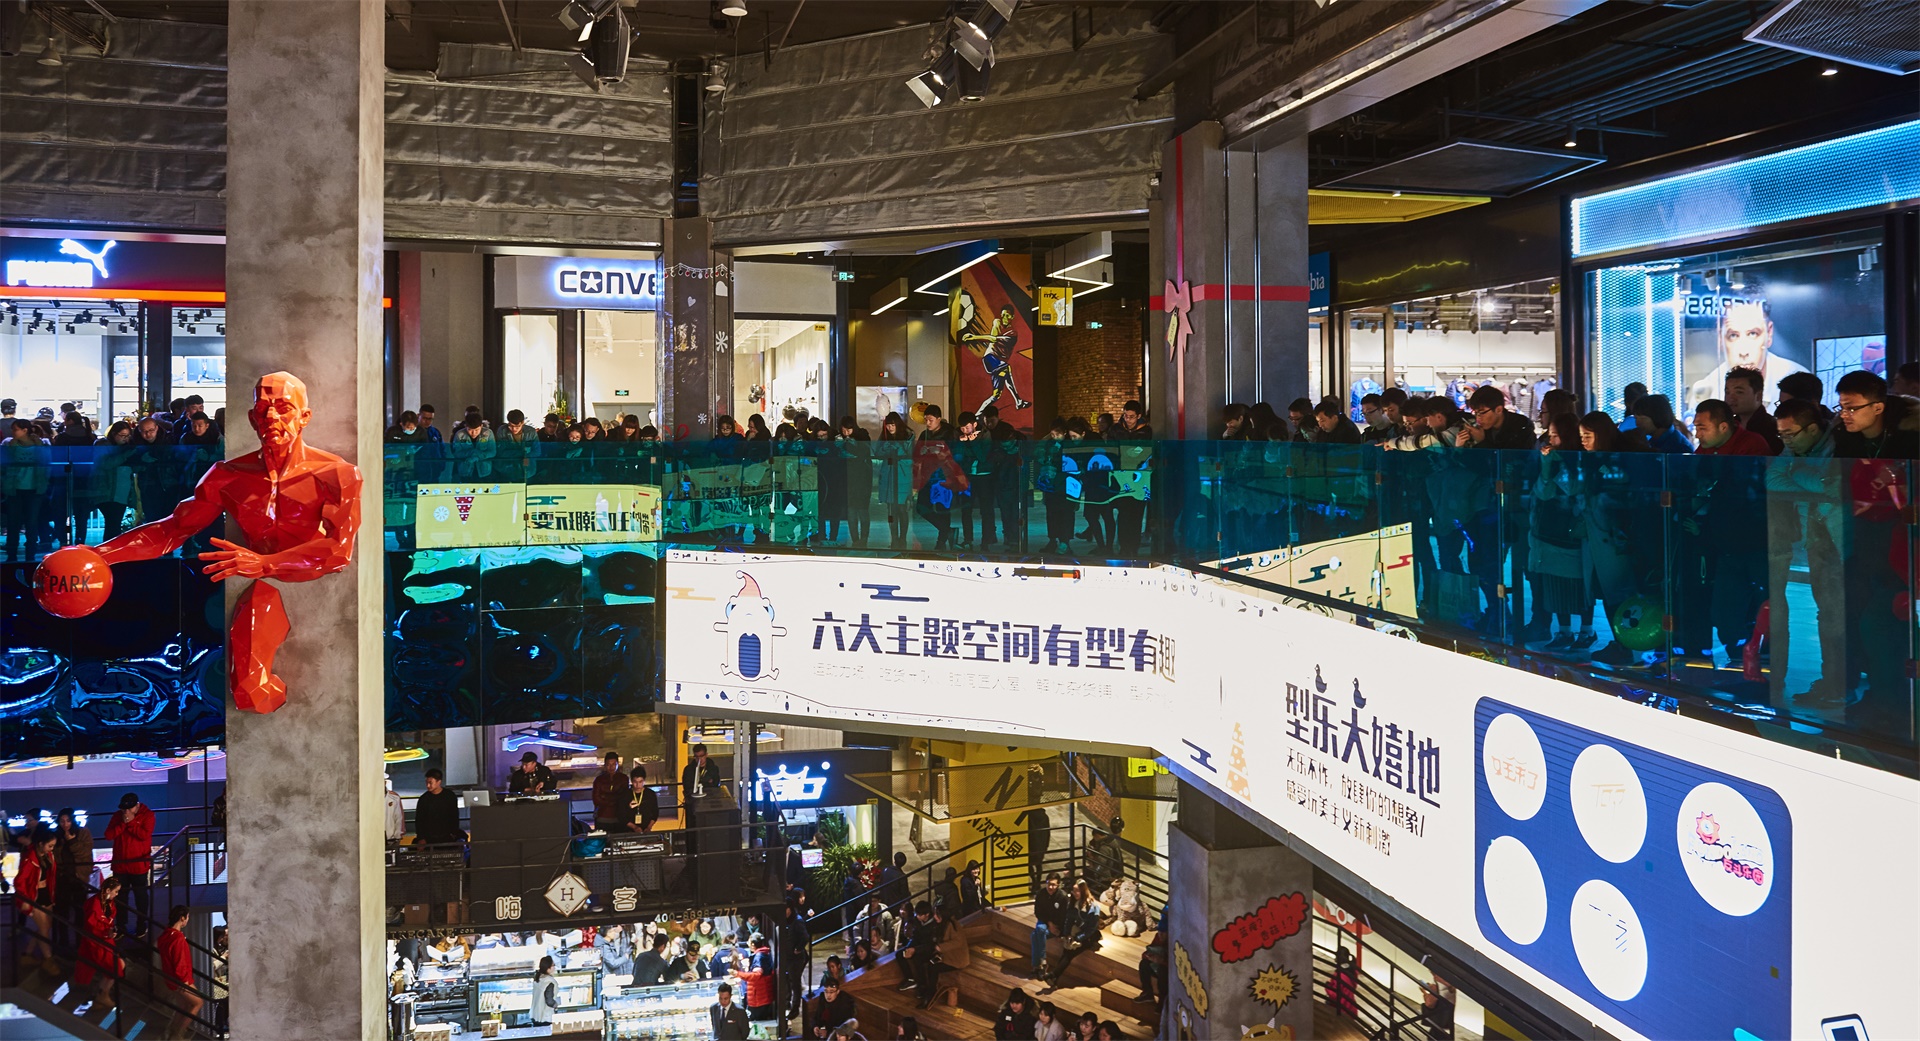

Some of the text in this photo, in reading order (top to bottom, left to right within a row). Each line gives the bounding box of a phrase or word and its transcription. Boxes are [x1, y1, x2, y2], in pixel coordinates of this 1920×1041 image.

[1308, 272, 1325, 291] bia
[49, 575, 91, 593] PARK
[812, 611, 1176, 683] 六大主题空间有型有趣
[1285, 682, 1441, 809] 型乐大嬉地
[495, 886, 638, 920] 嗨 H 客
[654, 907, 738, 923] 400-8898-777
